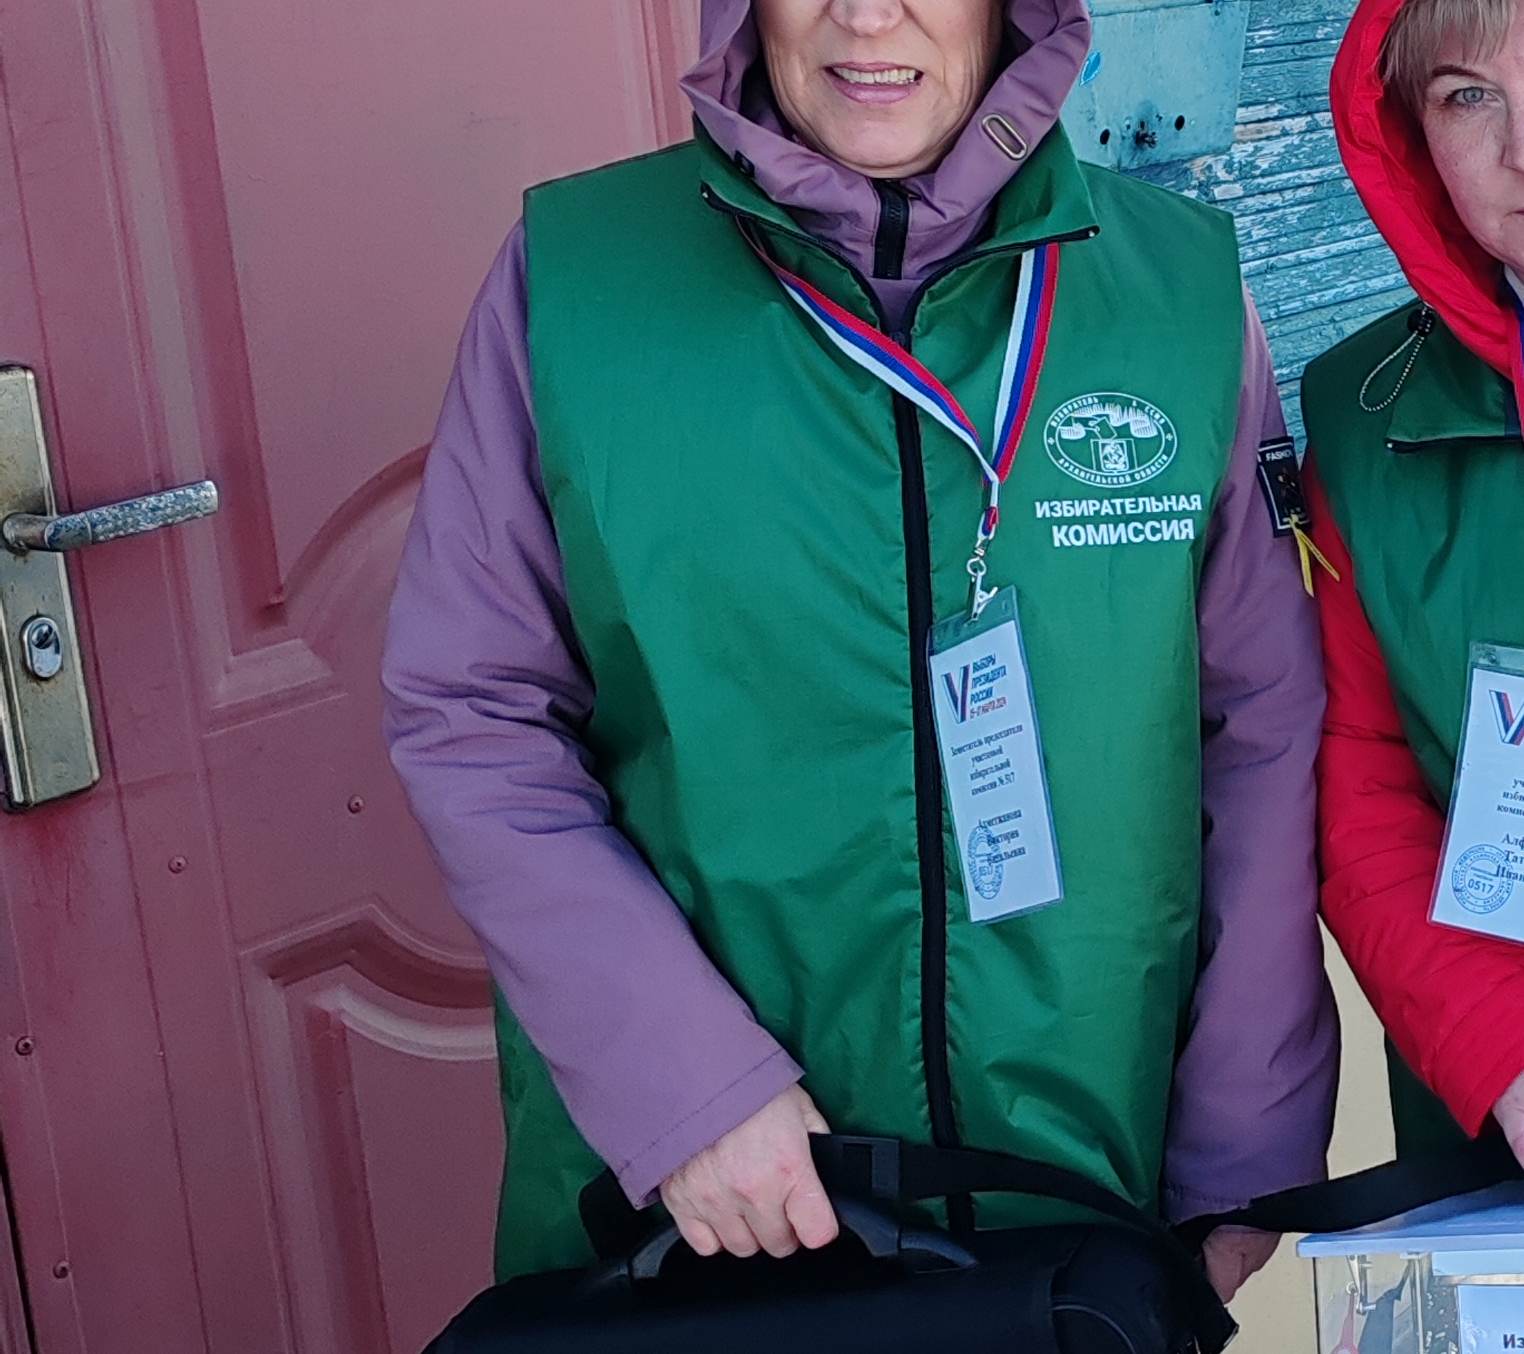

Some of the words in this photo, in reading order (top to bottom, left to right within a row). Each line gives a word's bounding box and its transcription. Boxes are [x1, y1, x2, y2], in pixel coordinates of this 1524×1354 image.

[1034, 494, 1203, 519] ИЗБИРАТЕЛЬНАЯ
[1052, 518, 1196, 548] КОМИССИЯ
[1467, 878, 1495, 894] 0517
